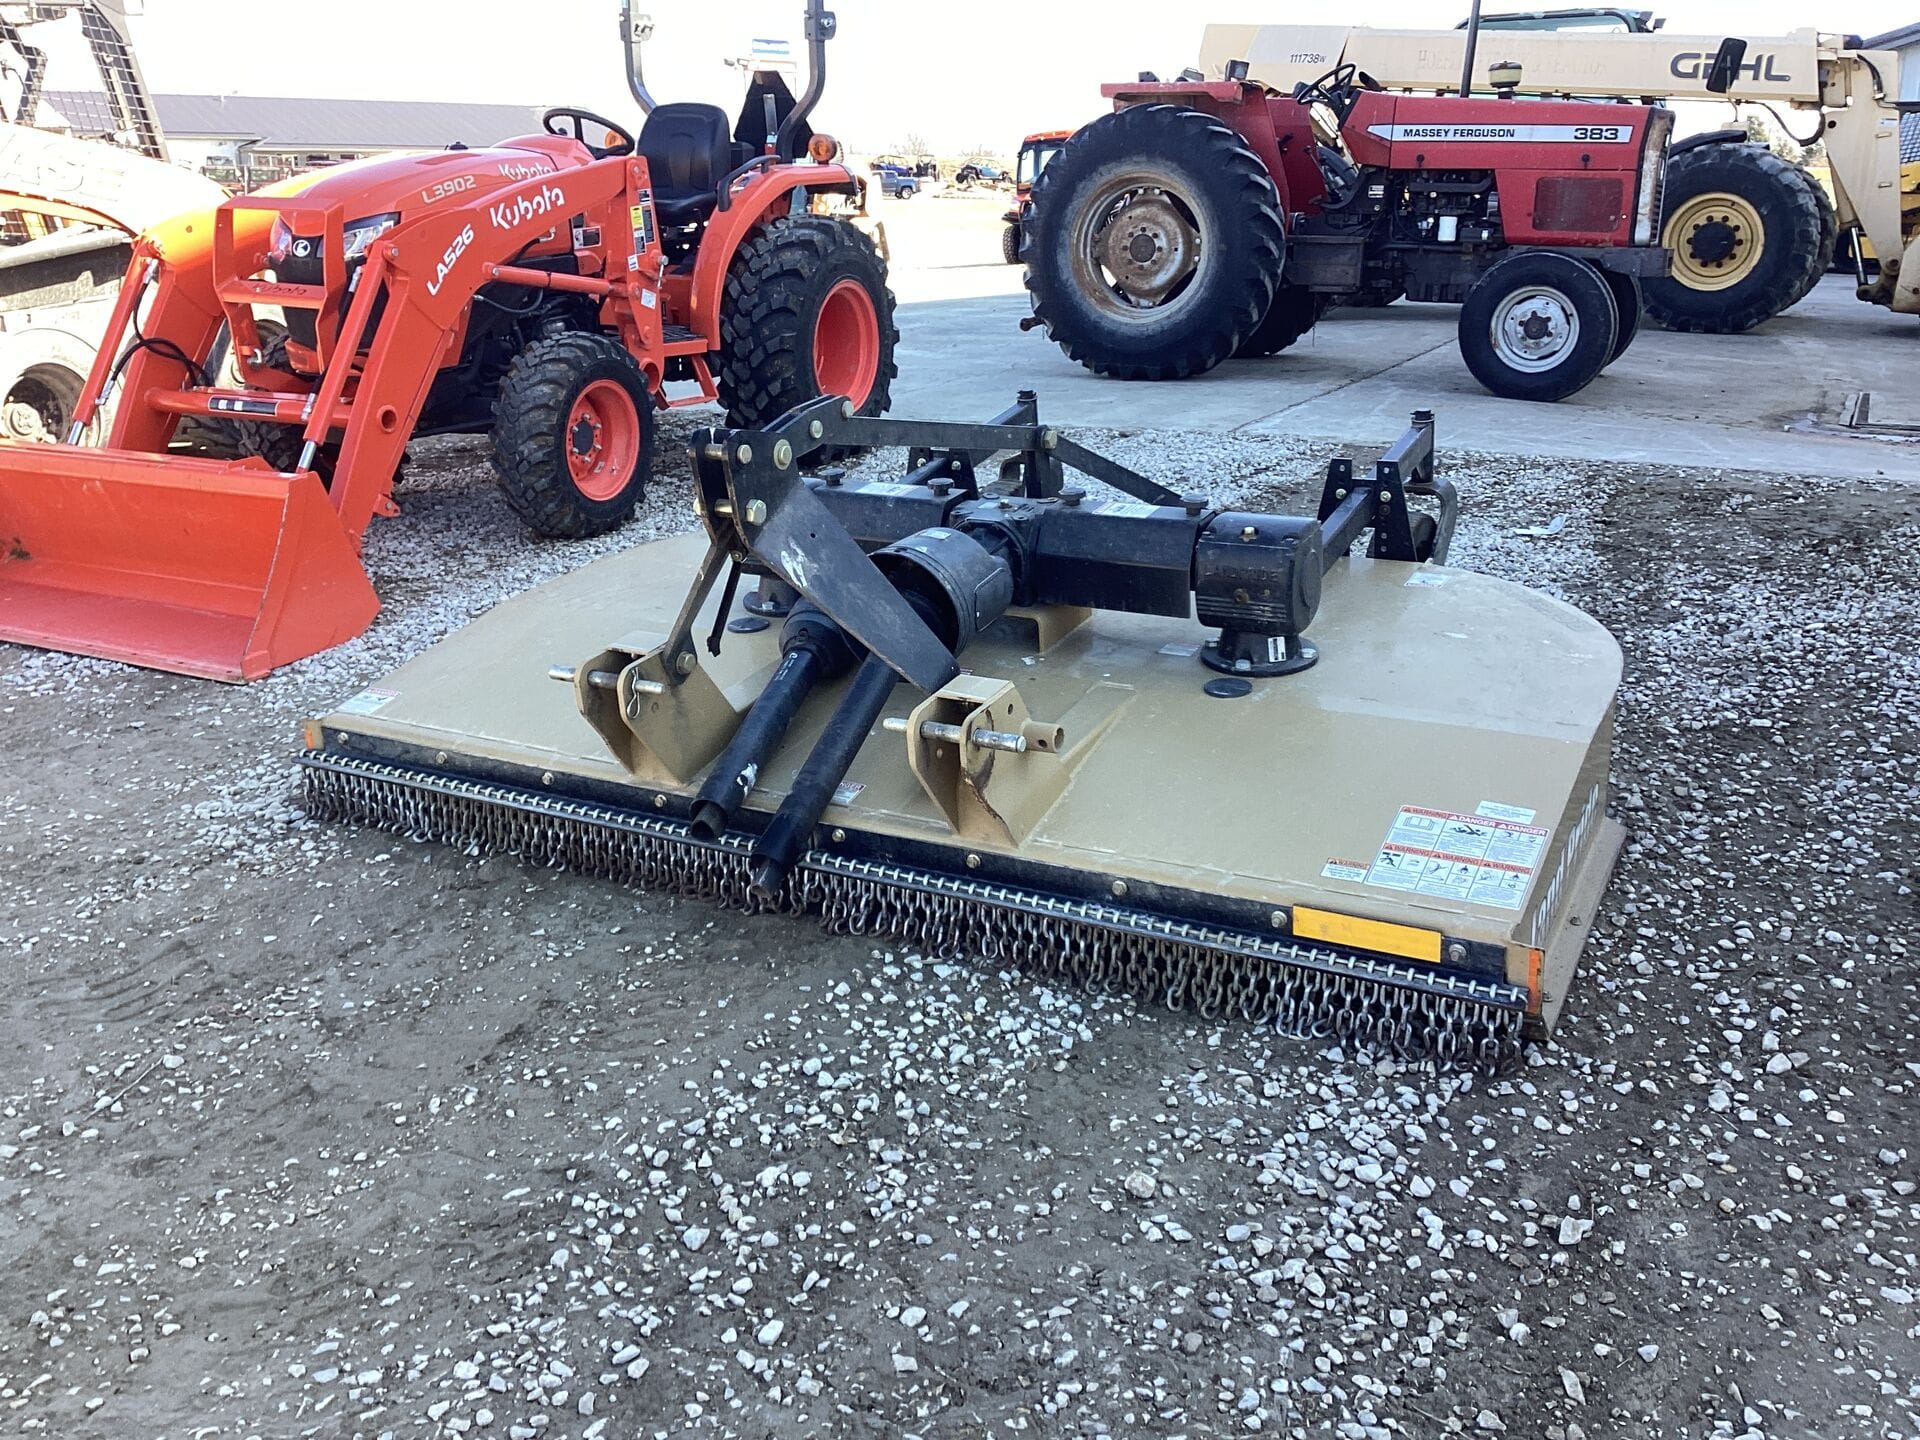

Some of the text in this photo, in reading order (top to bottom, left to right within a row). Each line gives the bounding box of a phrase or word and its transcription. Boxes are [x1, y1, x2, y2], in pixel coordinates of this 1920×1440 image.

[1403, 128, 1619, 140] MASSEY FERGUSON 383
[421, 175, 477, 204] L3902
[490, 185, 566, 230] Kubota
[426, 223, 475, 296] LA526
[1458, 816, 1496, 828] DANGER
[1507, 824, 1547, 836] DANGER
